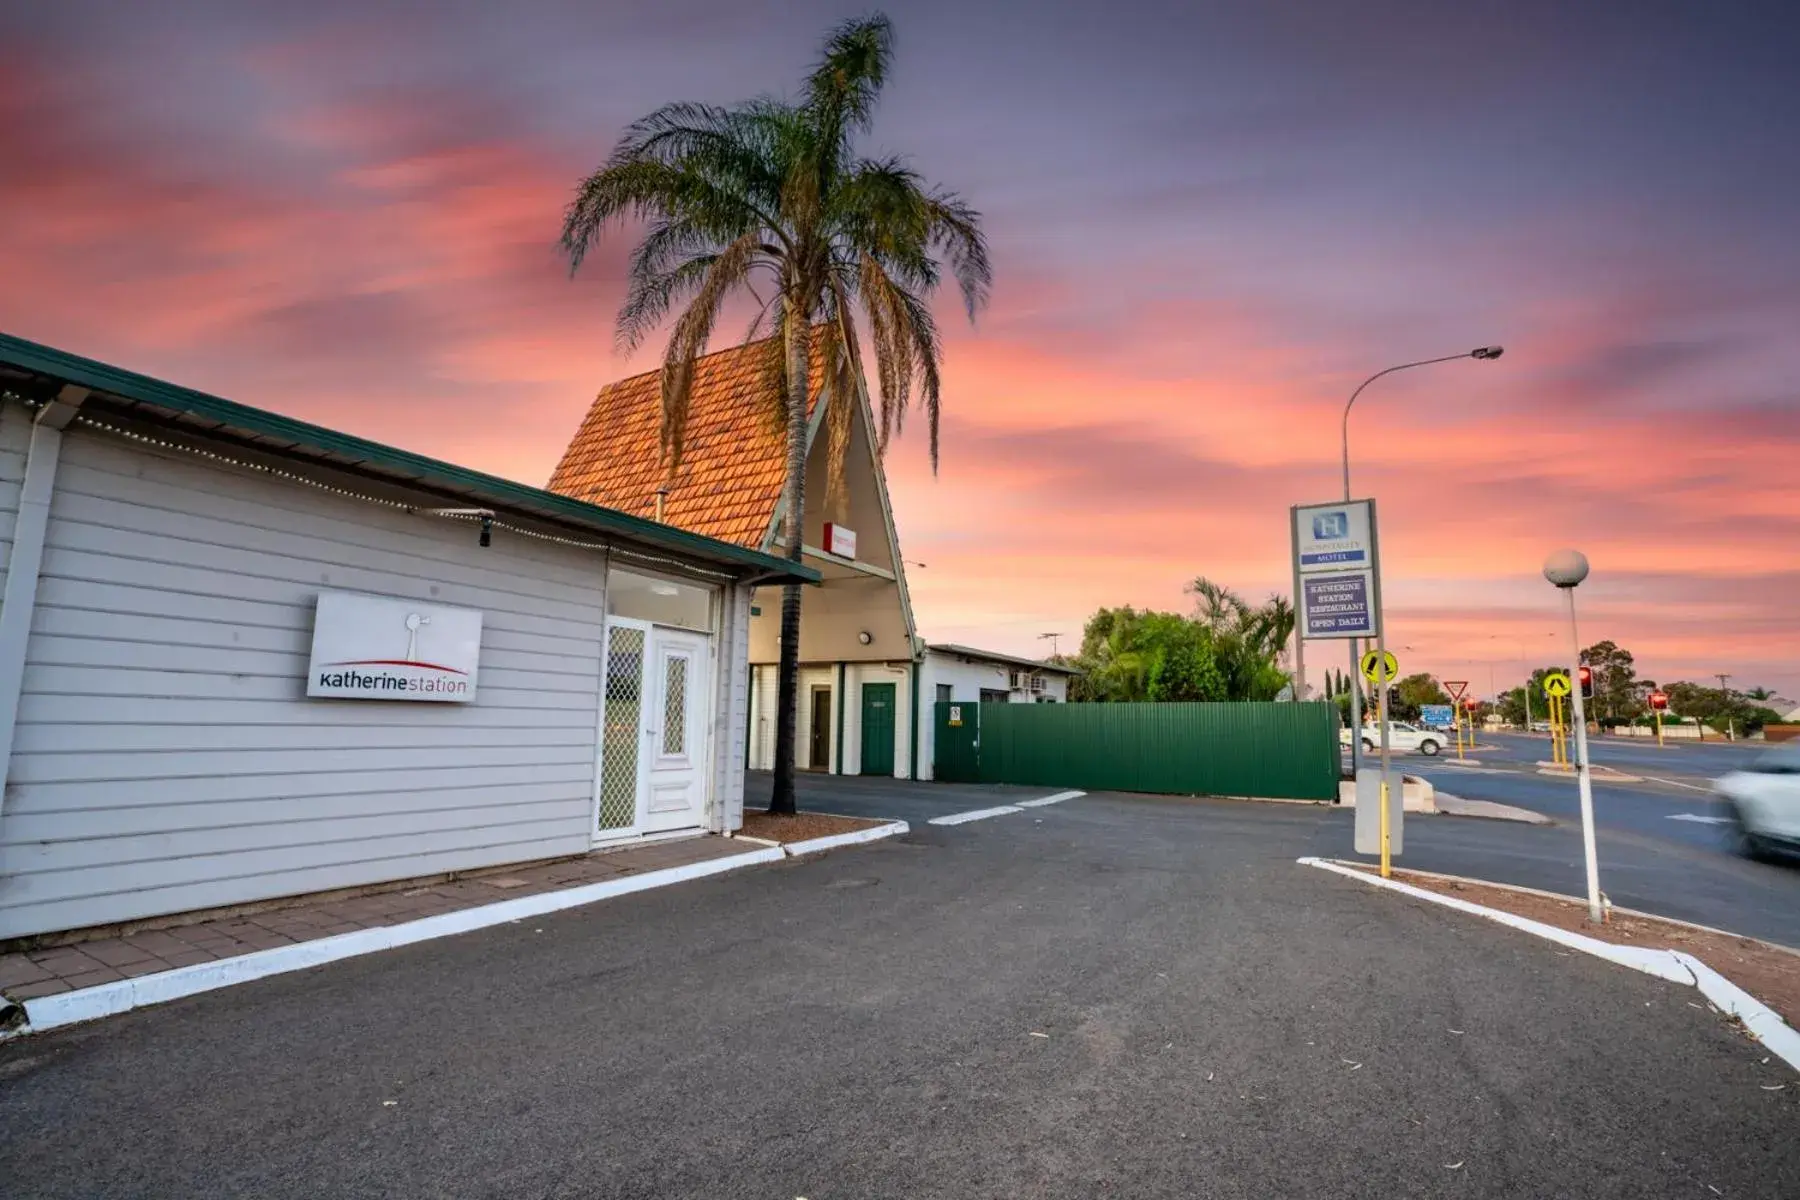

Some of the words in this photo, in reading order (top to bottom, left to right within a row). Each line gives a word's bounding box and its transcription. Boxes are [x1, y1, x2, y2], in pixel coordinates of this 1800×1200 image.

[1317, 552, 1347, 563] MOTEL
[1310, 582, 1361, 594] KATHERINE
[1317, 593, 1354, 604] STATION
[1309, 602, 1365, 614] RESTAURANT
[1310, 618, 1335, 629] OPEN
[1338, 616, 1366, 627] DAILY
